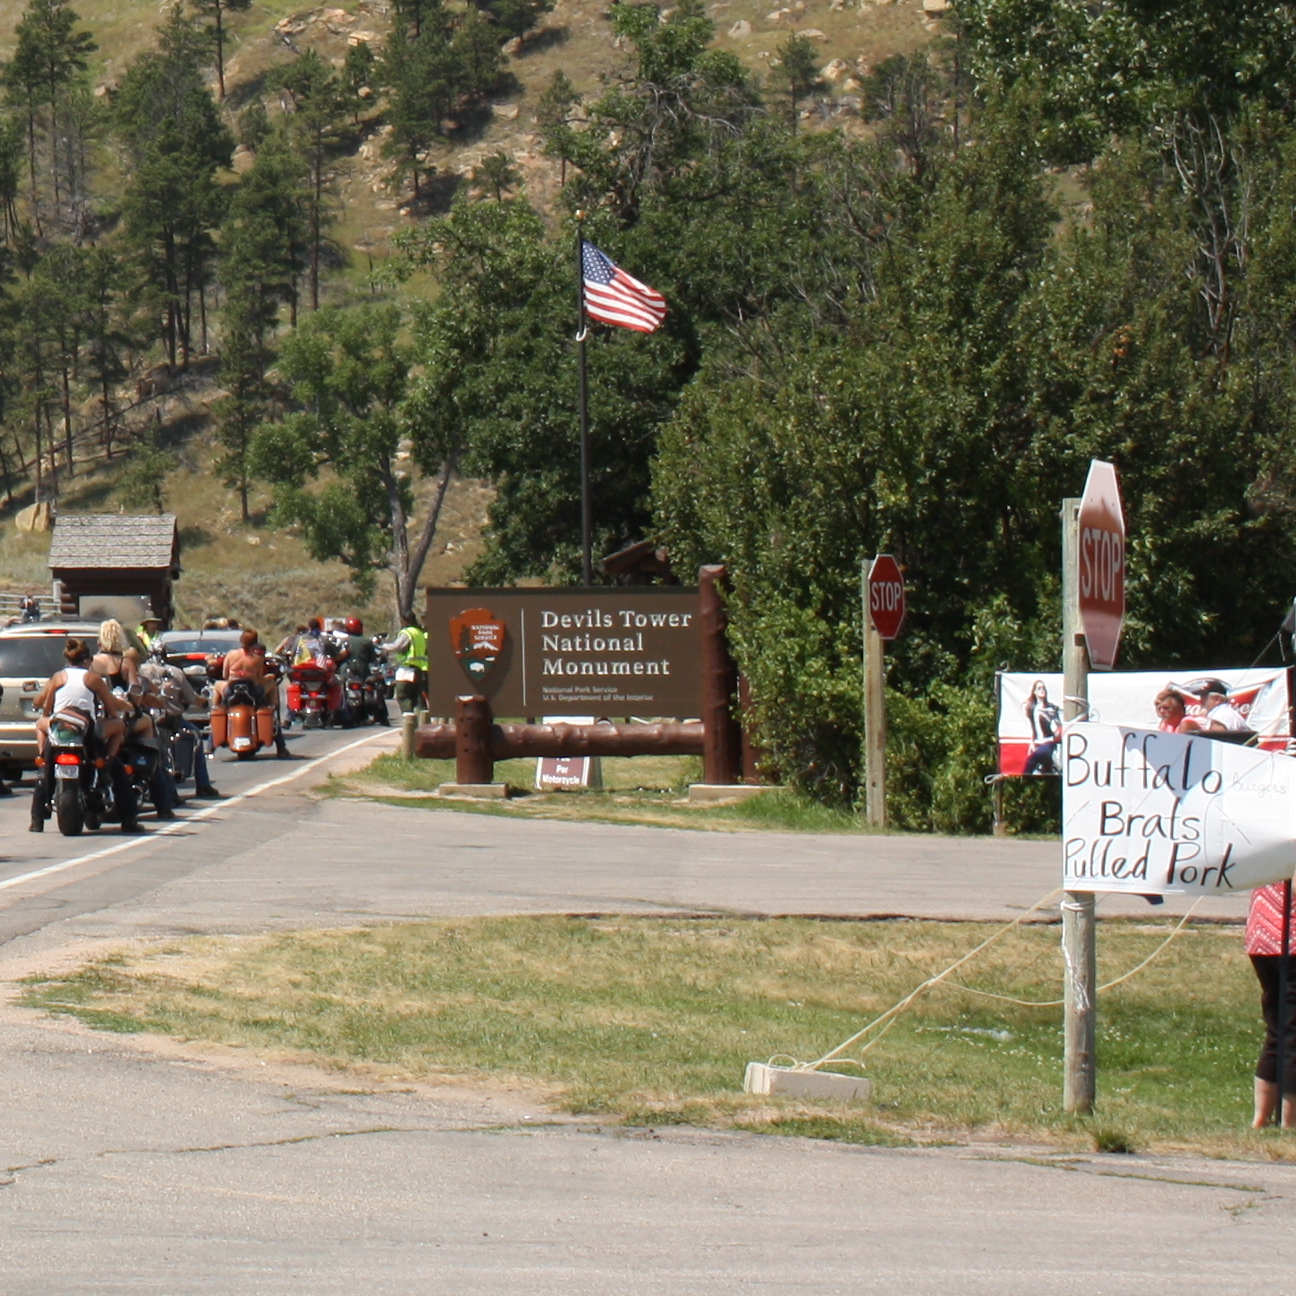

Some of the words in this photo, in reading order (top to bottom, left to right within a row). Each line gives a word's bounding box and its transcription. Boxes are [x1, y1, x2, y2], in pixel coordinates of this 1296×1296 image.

[1082, 527, 1121, 602] STOP
[871, 582, 901, 612] STOP
[541, 609, 613, 628] Devils
[618, 610, 692, 628] Tower
[541, 633, 644, 652] National
[542, 658, 670, 676] Monument
[556, 764, 569, 774] Per
[1066, 732, 1223, 794] Buffalo
[542, 774, 580, 785] Motorcycle
[1099, 797, 1201, 841] Brats
[1064, 837, 1152, 881] Pulled
[1166, 842, 1237, 888] Pork
